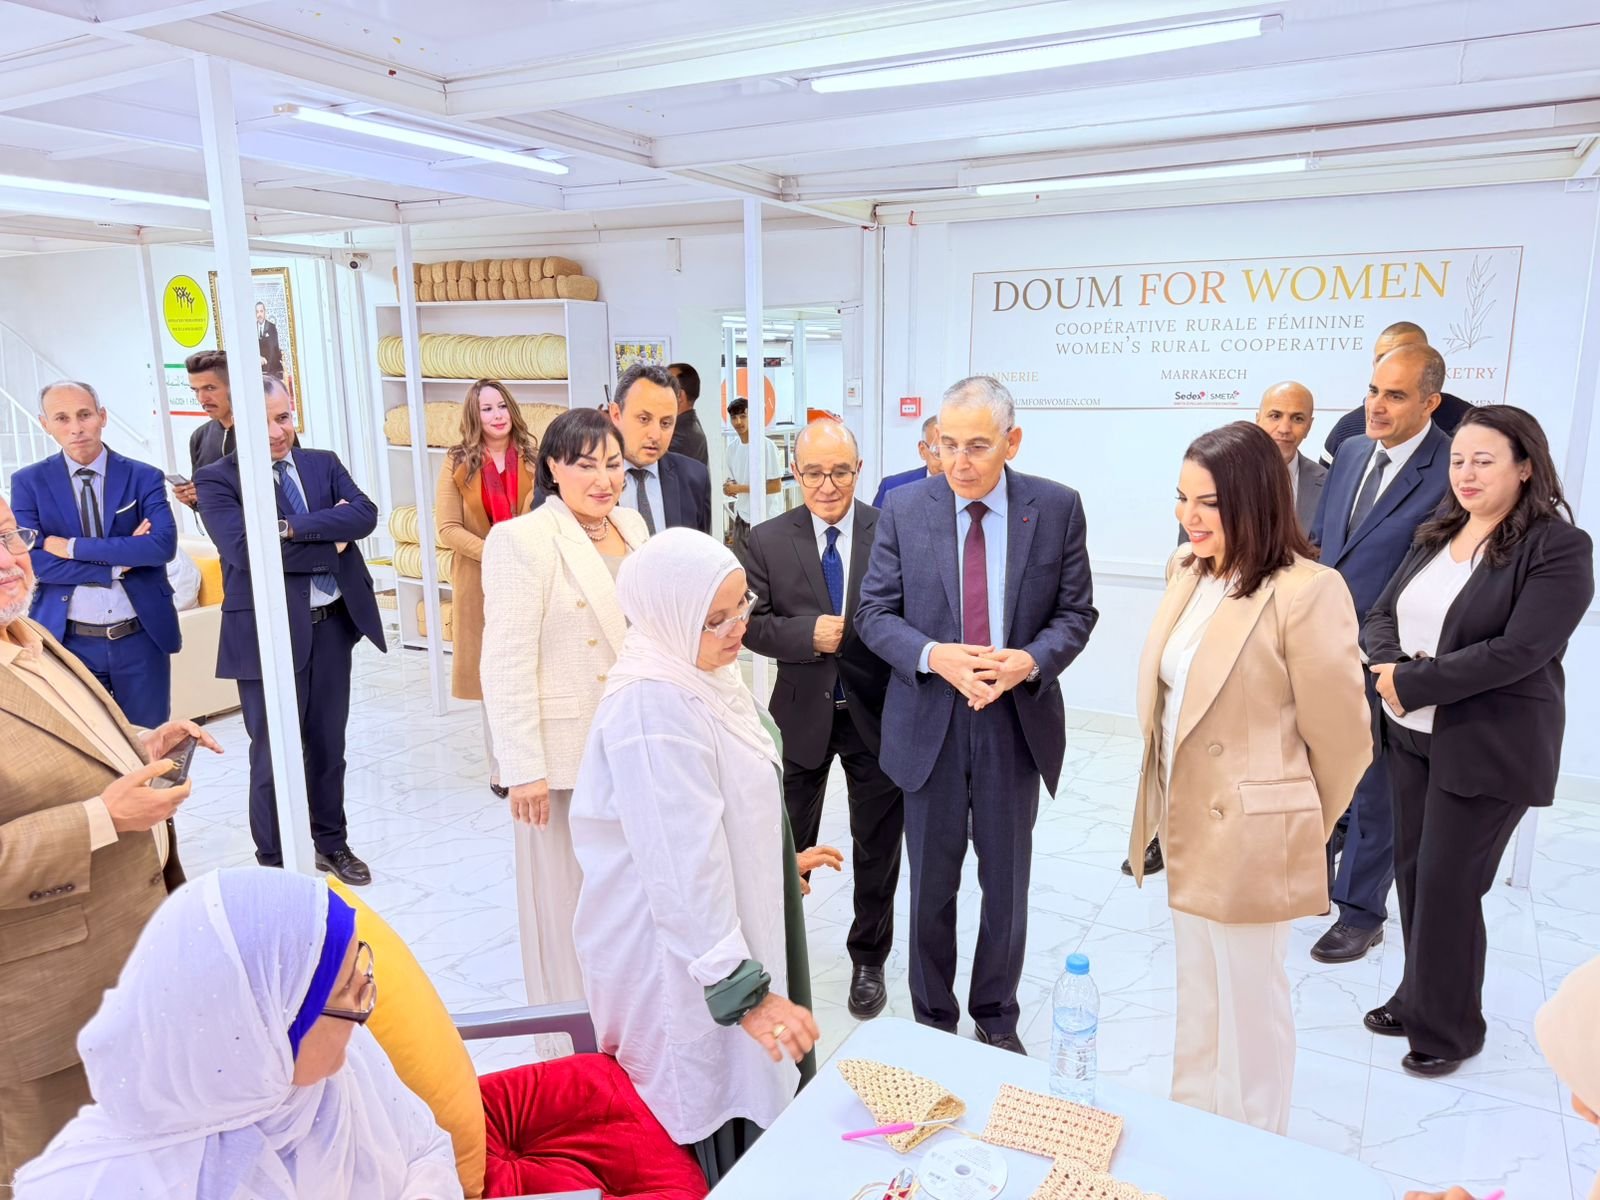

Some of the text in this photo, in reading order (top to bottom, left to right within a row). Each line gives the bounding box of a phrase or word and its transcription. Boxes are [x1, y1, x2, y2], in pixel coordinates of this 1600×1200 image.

[992, 261, 1452, 312] DOUM FOR WOMEN
[1055, 313, 1365, 335] COOPÉRATIVE RURALE FÉMININE
[1056, 335, 1363, 355] WOMEN'S RURAL COOPERATIVE
[1161, 368, 1247, 380] MARRAKECH
[1014, 398, 1101, 406] UMFORWOMEN.COM
[1175, 391, 1202, 400] Sedex
